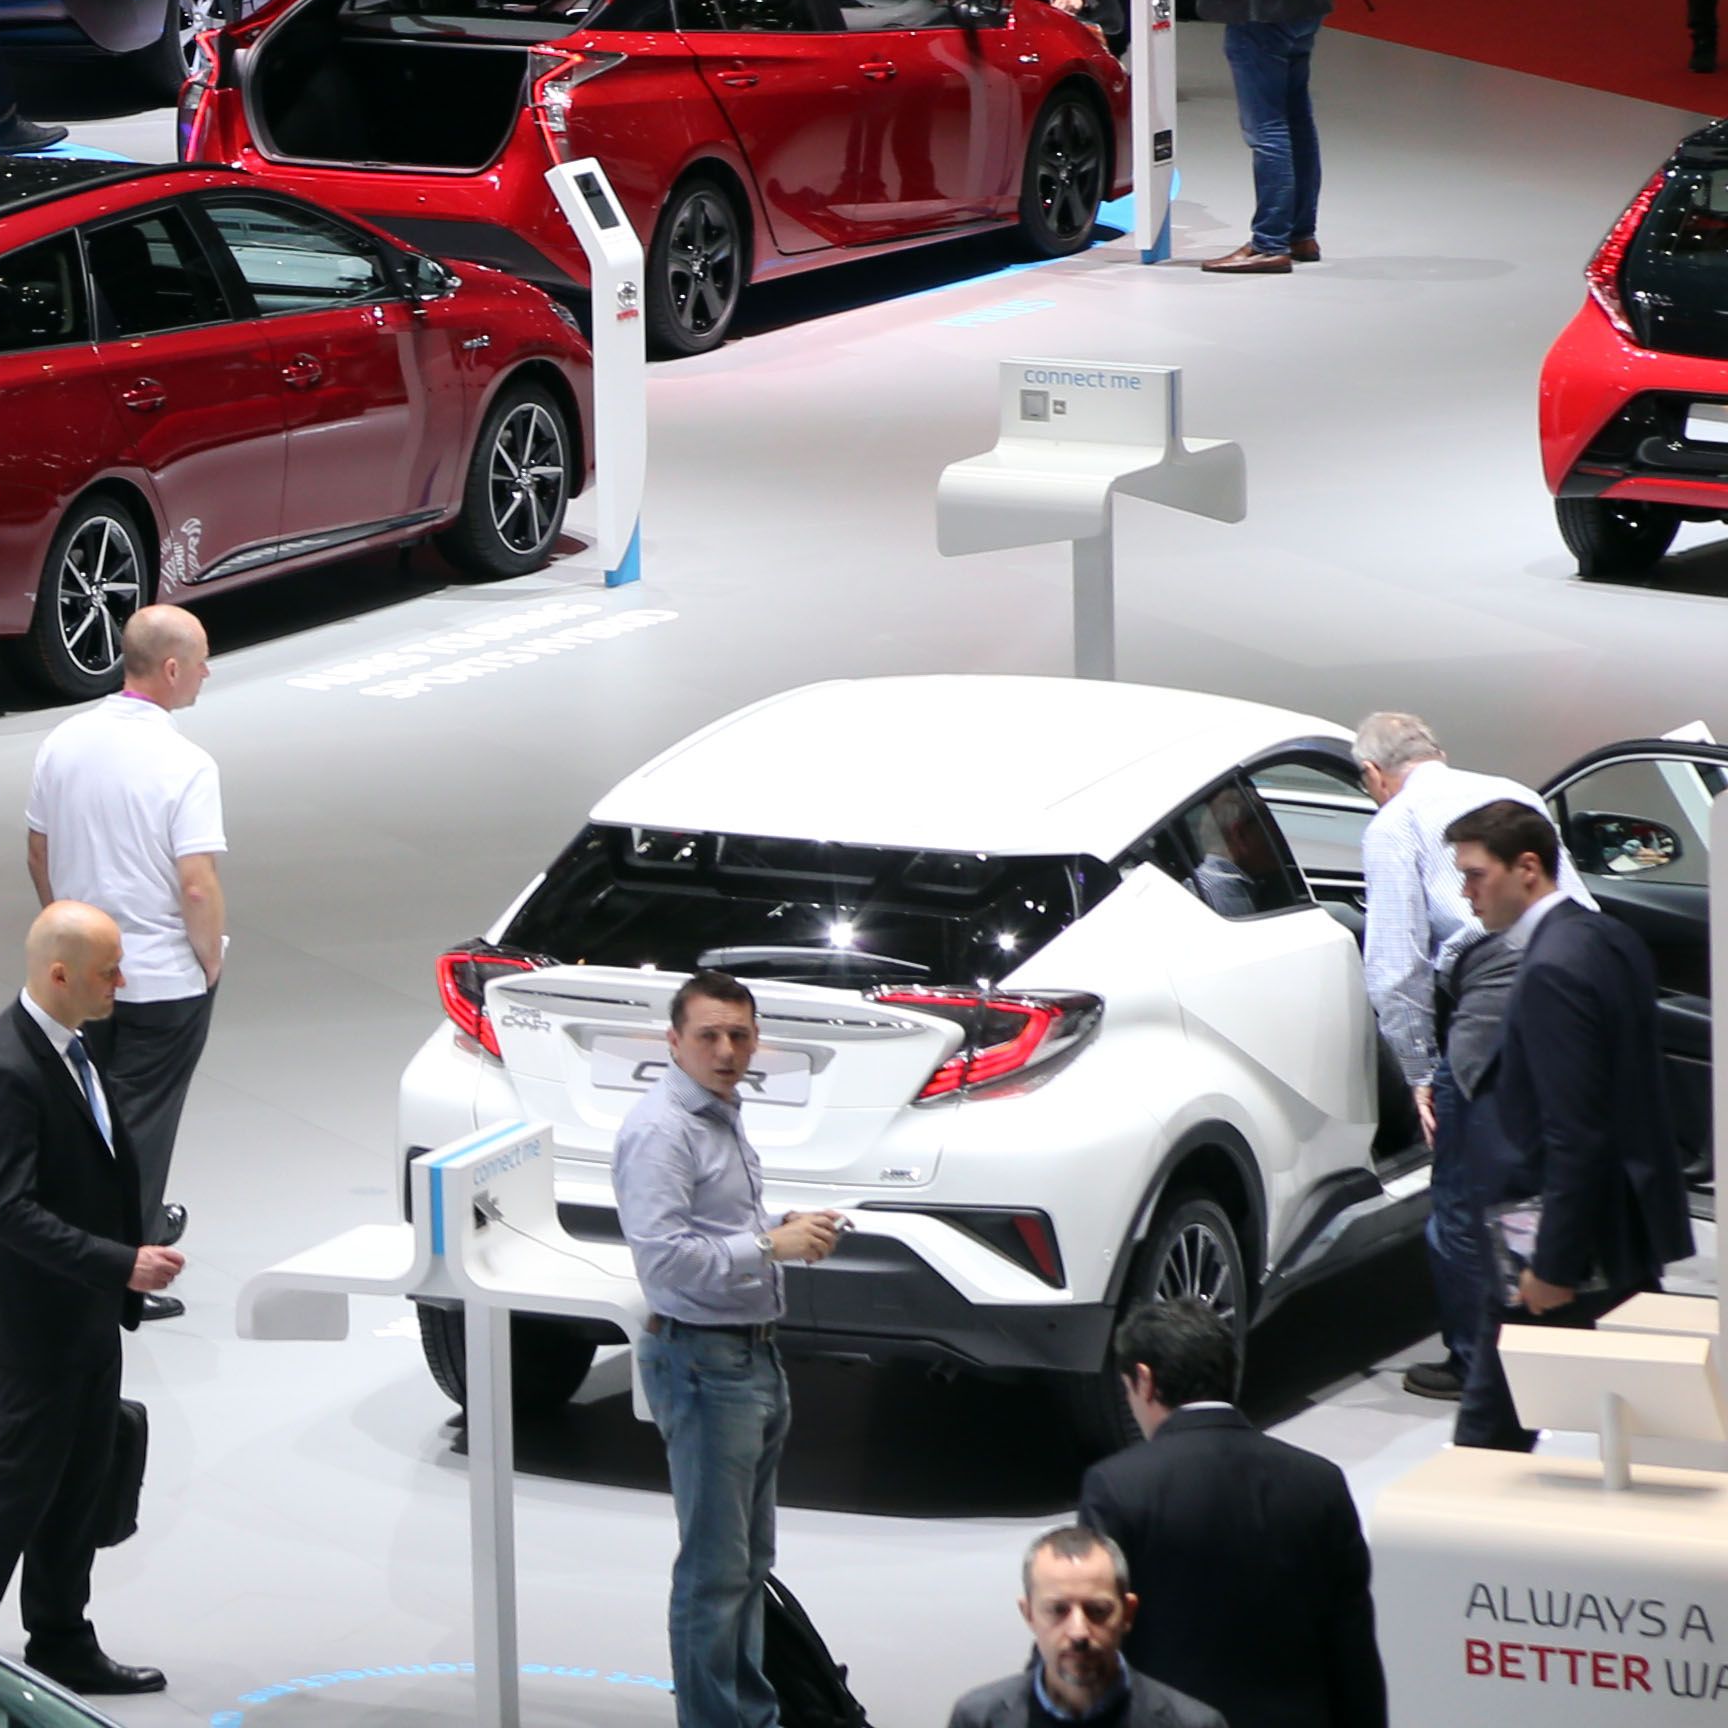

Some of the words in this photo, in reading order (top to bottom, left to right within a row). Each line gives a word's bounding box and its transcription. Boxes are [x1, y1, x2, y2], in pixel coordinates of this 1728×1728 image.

[1024, 369, 1107, 388] connect
[1110, 374, 1142, 390] me
[473, 1144, 521, 1185] connect
[522, 1139, 542, 1159] me
[1465, 1583, 1668, 1639] ALWAYS
[1680, 1604, 1714, 1643] A
[1465, 1638, 1653, 1693] BETTER
